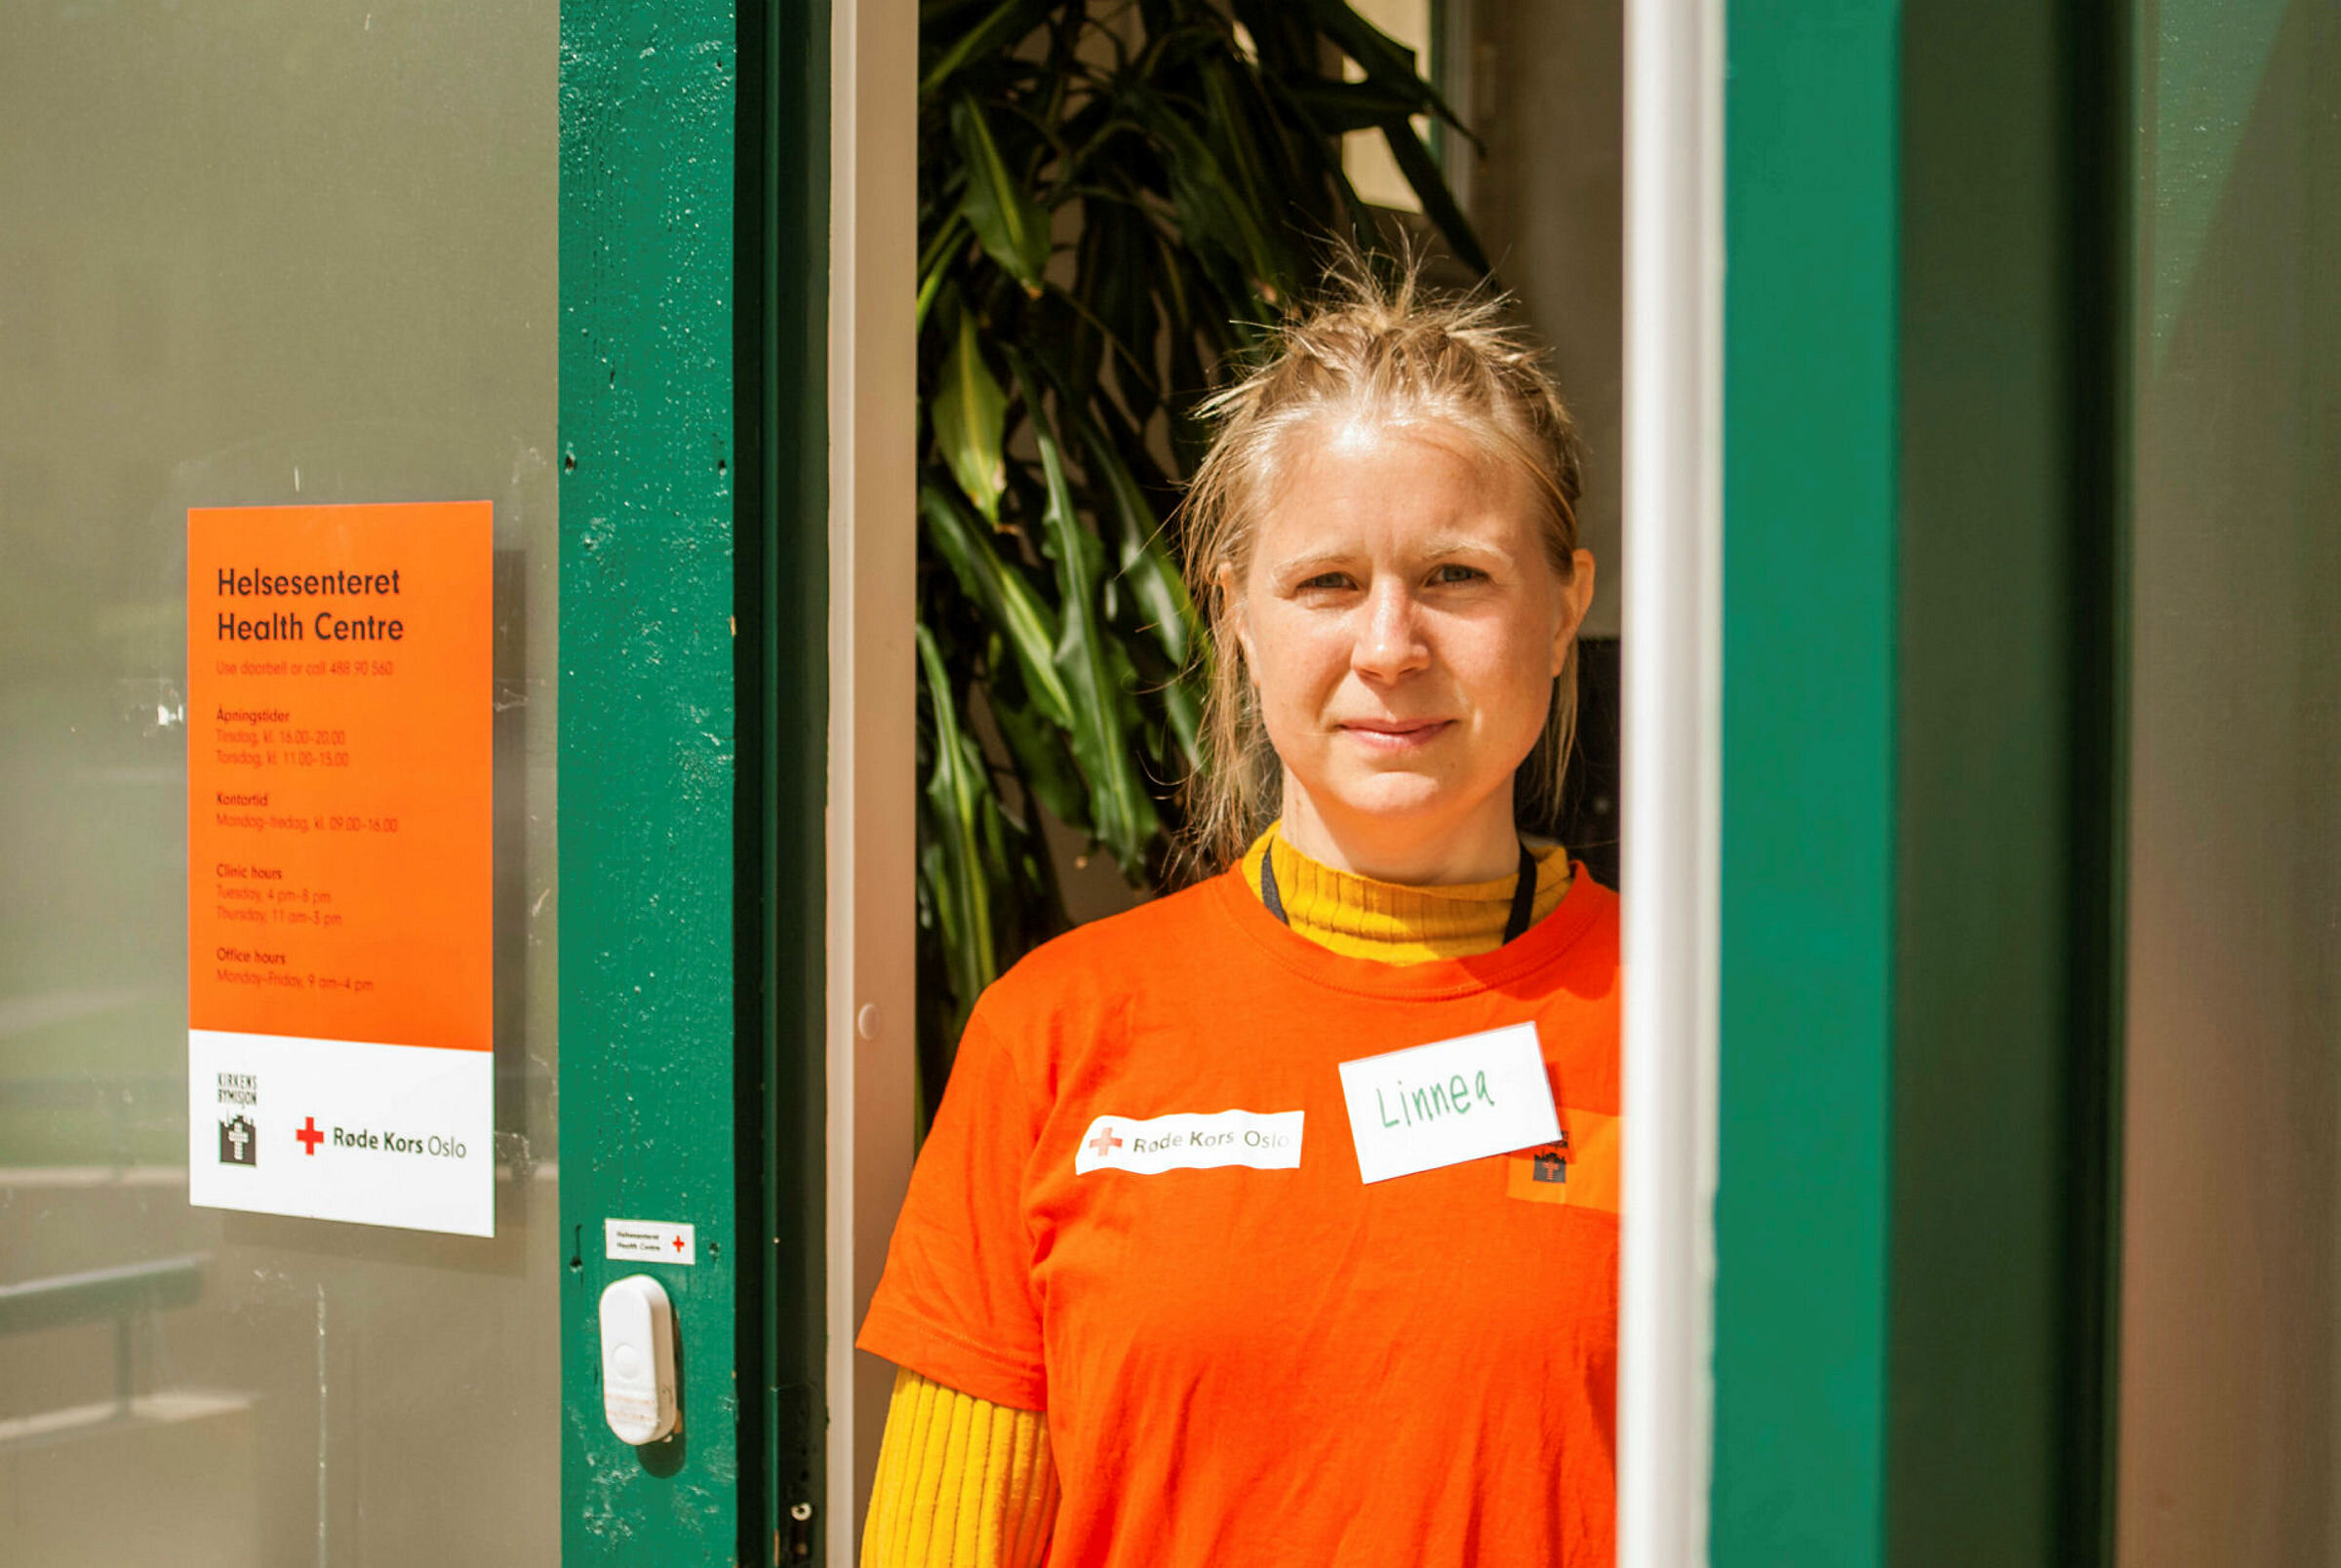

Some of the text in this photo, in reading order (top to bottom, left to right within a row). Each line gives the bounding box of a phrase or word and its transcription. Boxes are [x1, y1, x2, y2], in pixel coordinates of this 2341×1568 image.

[218, 568, 400, 596] Helsesenteret
[218, 611, 404, 641] Health Centre
[216, 661, 237, 676] Use
[240, 660, 288, 676] doorbell
[291, 663, 302, 676] or
[305, 660, 326, 676] call
[354, 660, 368, 676] 90
[216, 705, 290, 725] Åpningstider
[216, 792, 268, 807] Kontortid
[216, 864, 283, 880] Clinic hours
[267, 888, 274, 899] 4
[312, 891, 331, 905] pm
[324, 913, 342, 928] pm
[216, 947, 286, 965] Office hours
[307, 973, 315, 987] 9
[354, 979, 374, 992] pm
[218, 1072, 257, 1090] KIRKENS
[1376, 1070, 1495, 1128] Linnea
[334, 1127, 467, 1158] Røde Kors Oslo
[1189, 1130, 1235, 1148] Kors
[1244, 1129, 1290, 1149] Oslo
